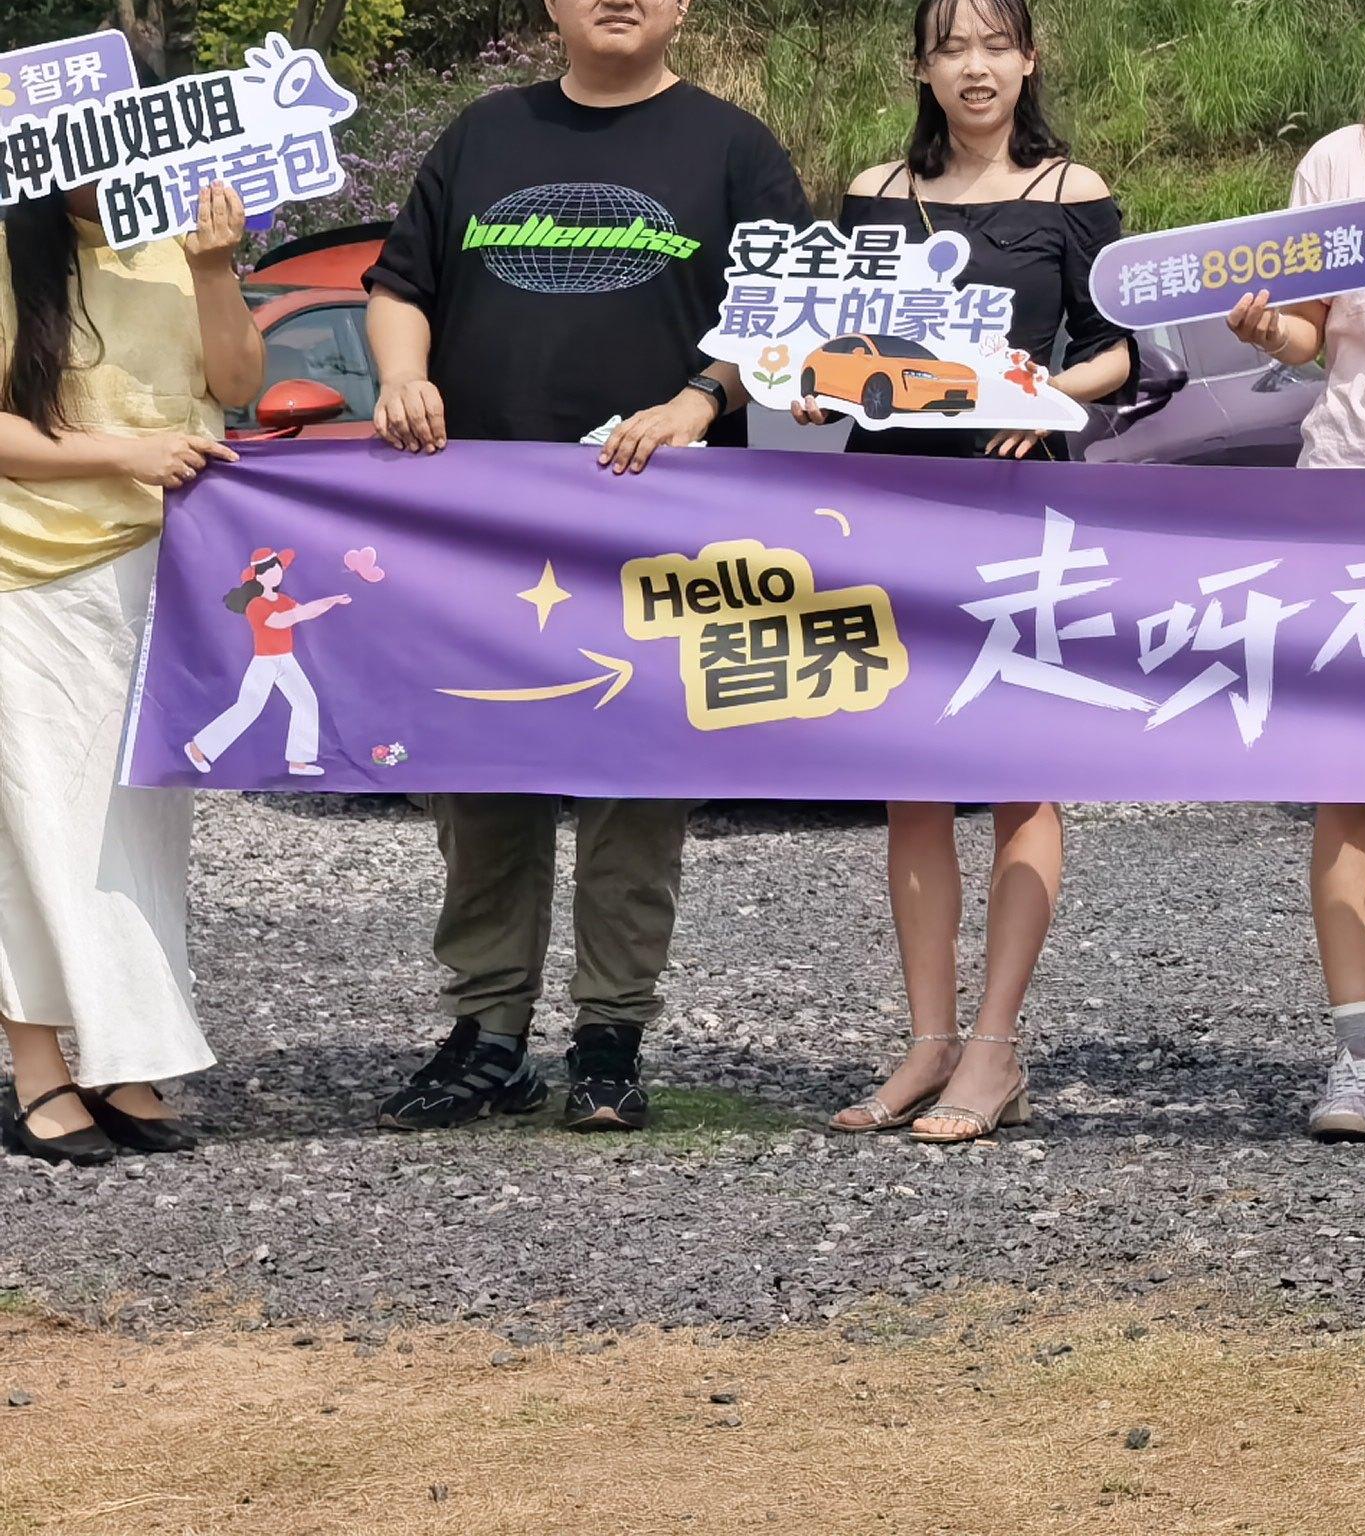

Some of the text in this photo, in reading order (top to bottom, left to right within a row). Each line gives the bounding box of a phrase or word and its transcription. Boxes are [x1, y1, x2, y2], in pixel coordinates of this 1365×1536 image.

[20, 51, 107, 106] 智界
[0, 76, 245, 199] 神仙姐姐
[105, 130, 337, 243] 的语音包
[728, 225, 902, 281] 安全是
[719, 285, 1012, 344] 最大的豪华
[639, 557, 795, 622] Hello
[699, 604, 889, 712] 智界
